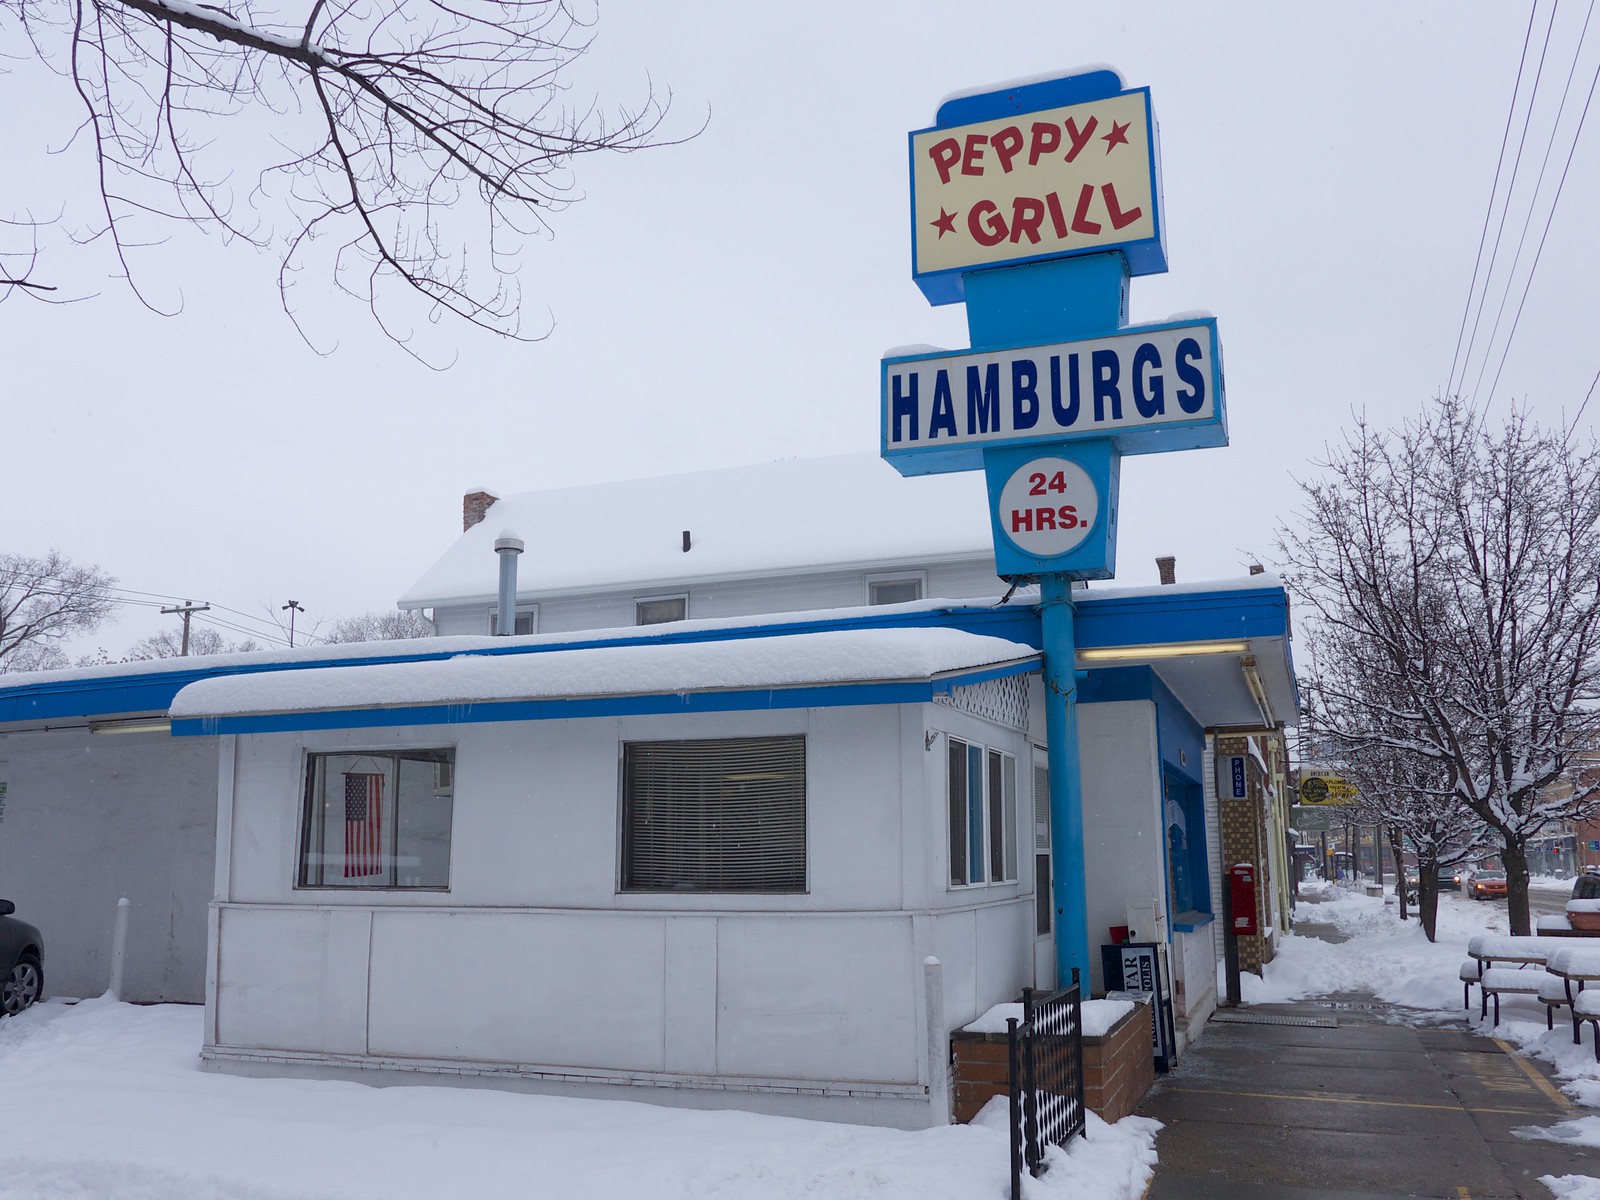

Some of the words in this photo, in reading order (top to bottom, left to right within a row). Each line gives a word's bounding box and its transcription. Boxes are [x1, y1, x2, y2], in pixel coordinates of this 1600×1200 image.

[929, 116, 1098, 184] PEPPY
[968, 182, 1142, 246] GRILL
[892, 338, 1205, 442] HAMBURGS
[1028, 471, 1067, 496] 24
[1011, 505, 1088, 532] HRS.
[1234, 760, 1242, 795] PHONE
[1124, 956, 1140, 990] TAR
